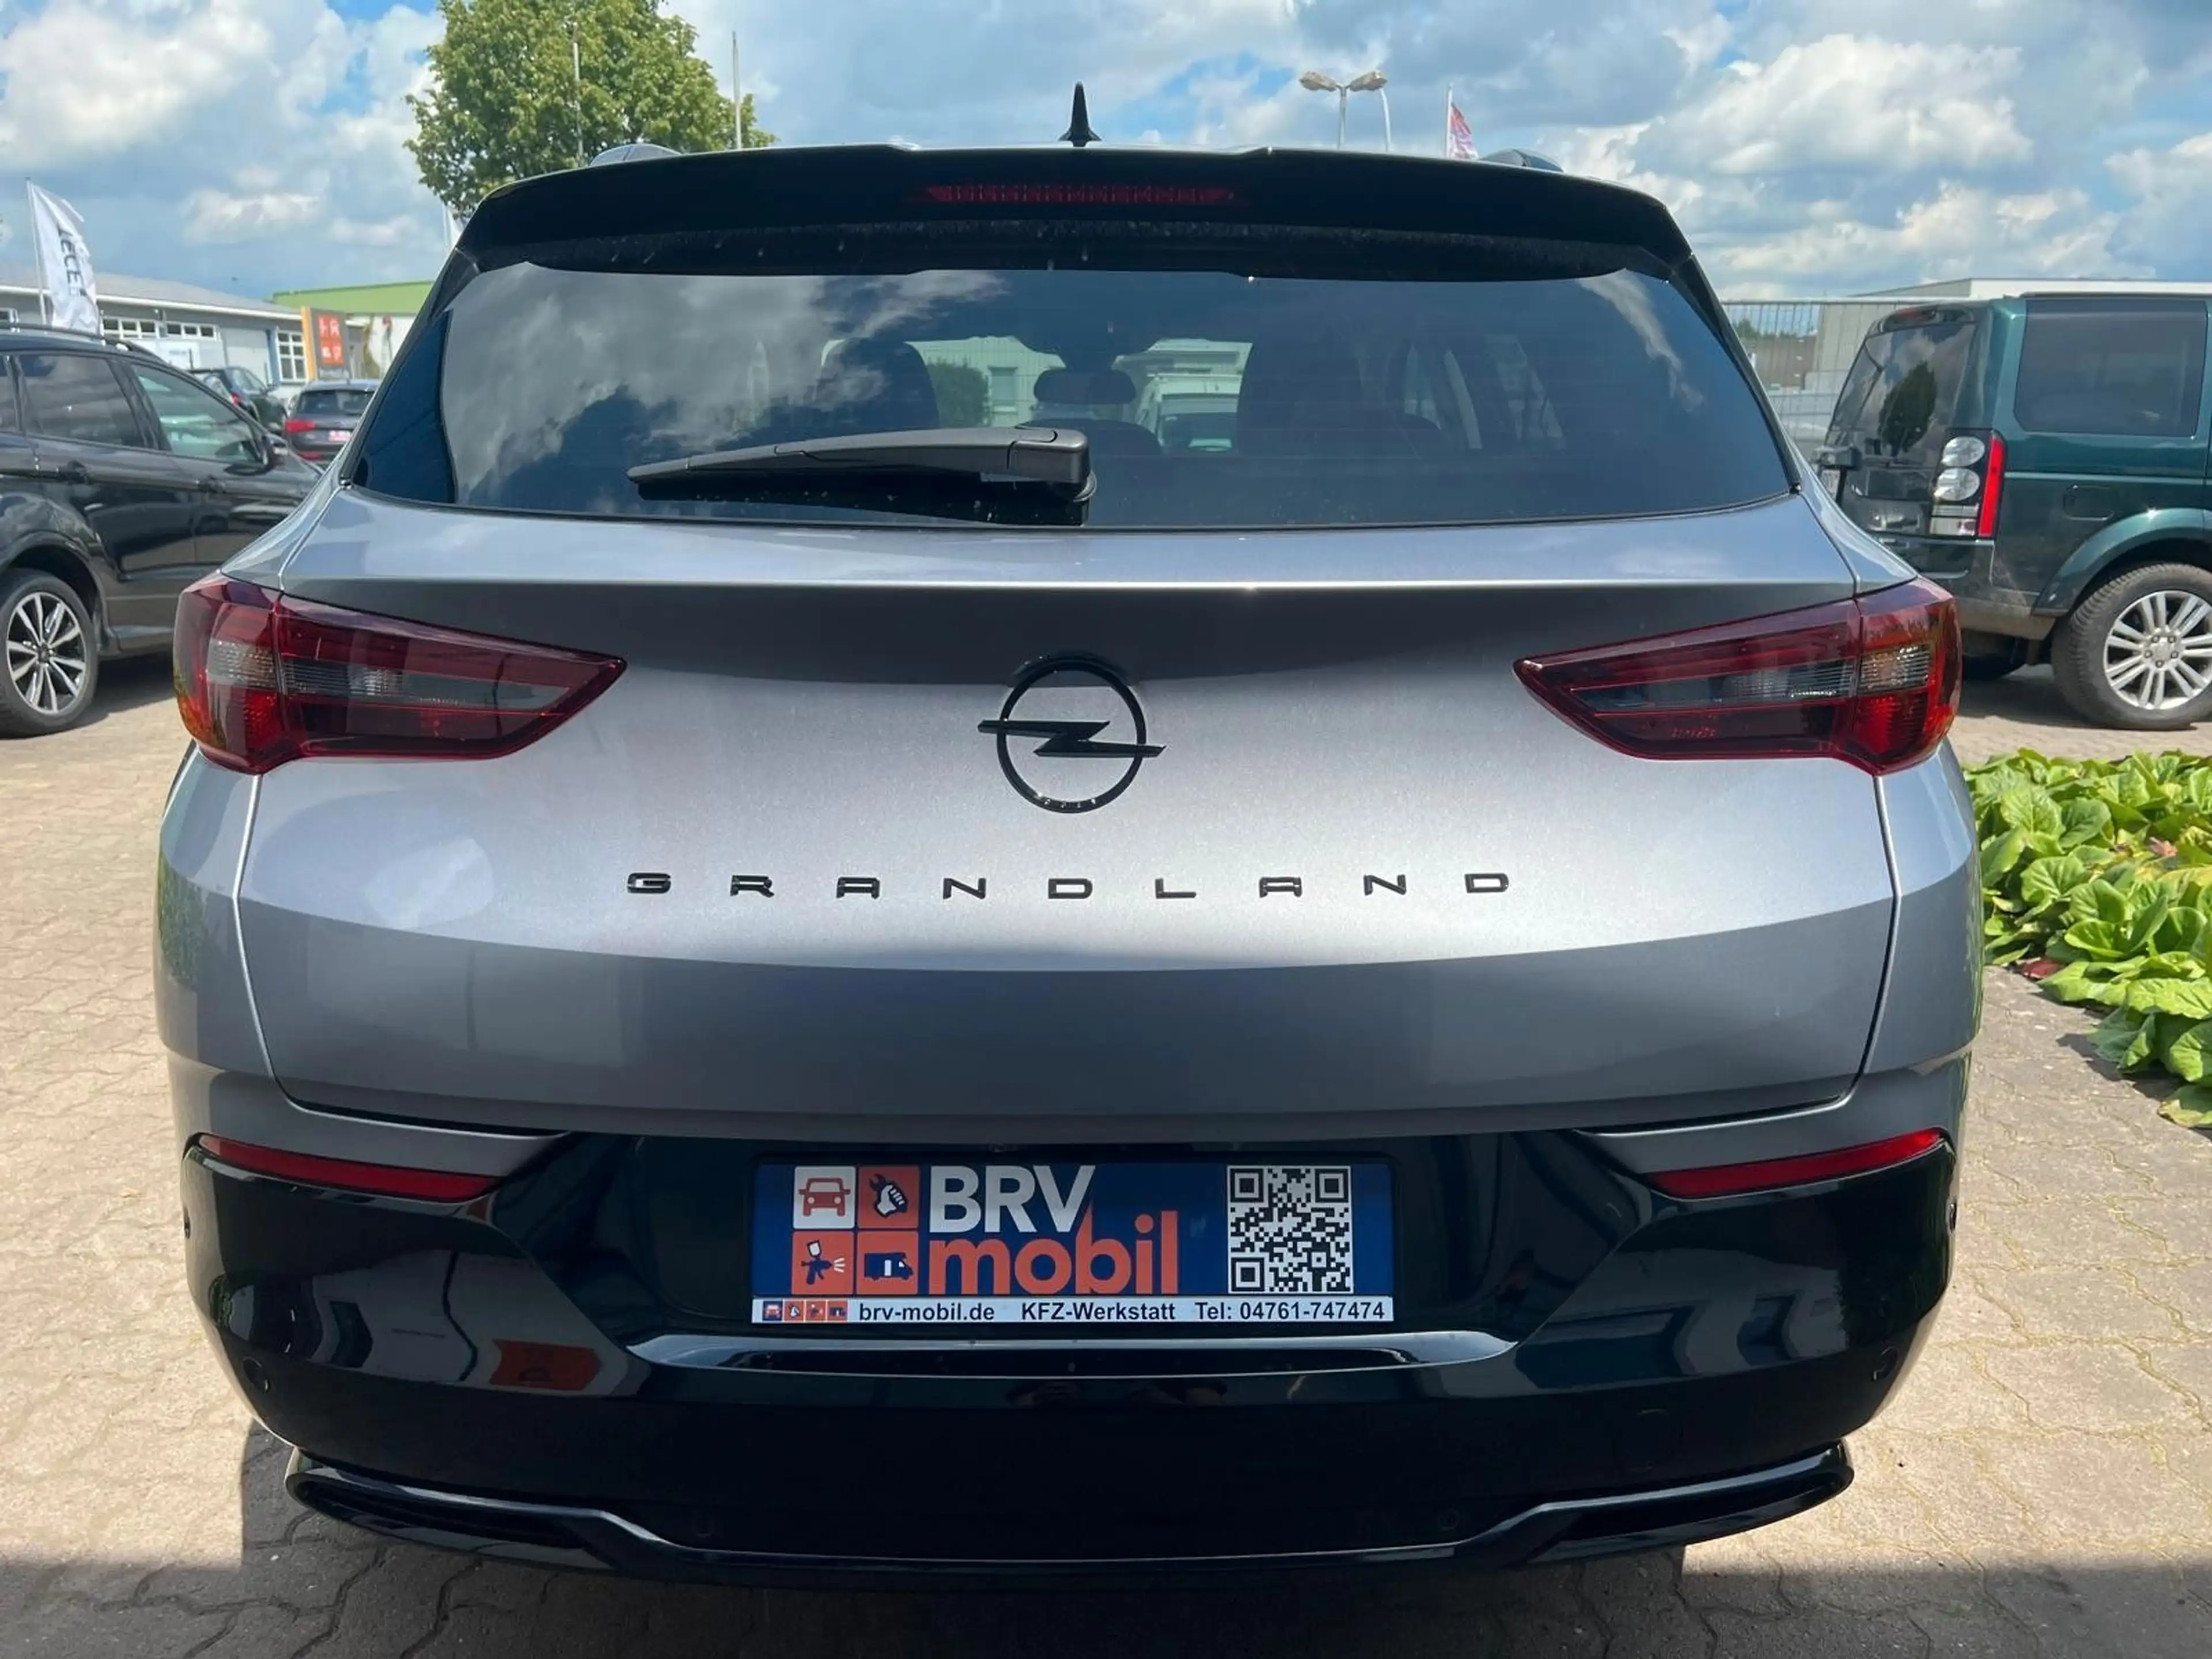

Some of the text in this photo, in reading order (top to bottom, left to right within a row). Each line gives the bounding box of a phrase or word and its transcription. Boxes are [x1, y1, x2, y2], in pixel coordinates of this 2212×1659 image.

[627, 871, 1510, 900] GRANDLAND
[929, 1165, 1096, 1233] BRV
[928, 1203, 1179, 1295] mobil
[859, 1301, 1385, 1321] brv-mobil.de KFZ-Werkstatt Tel: 04761-747474
